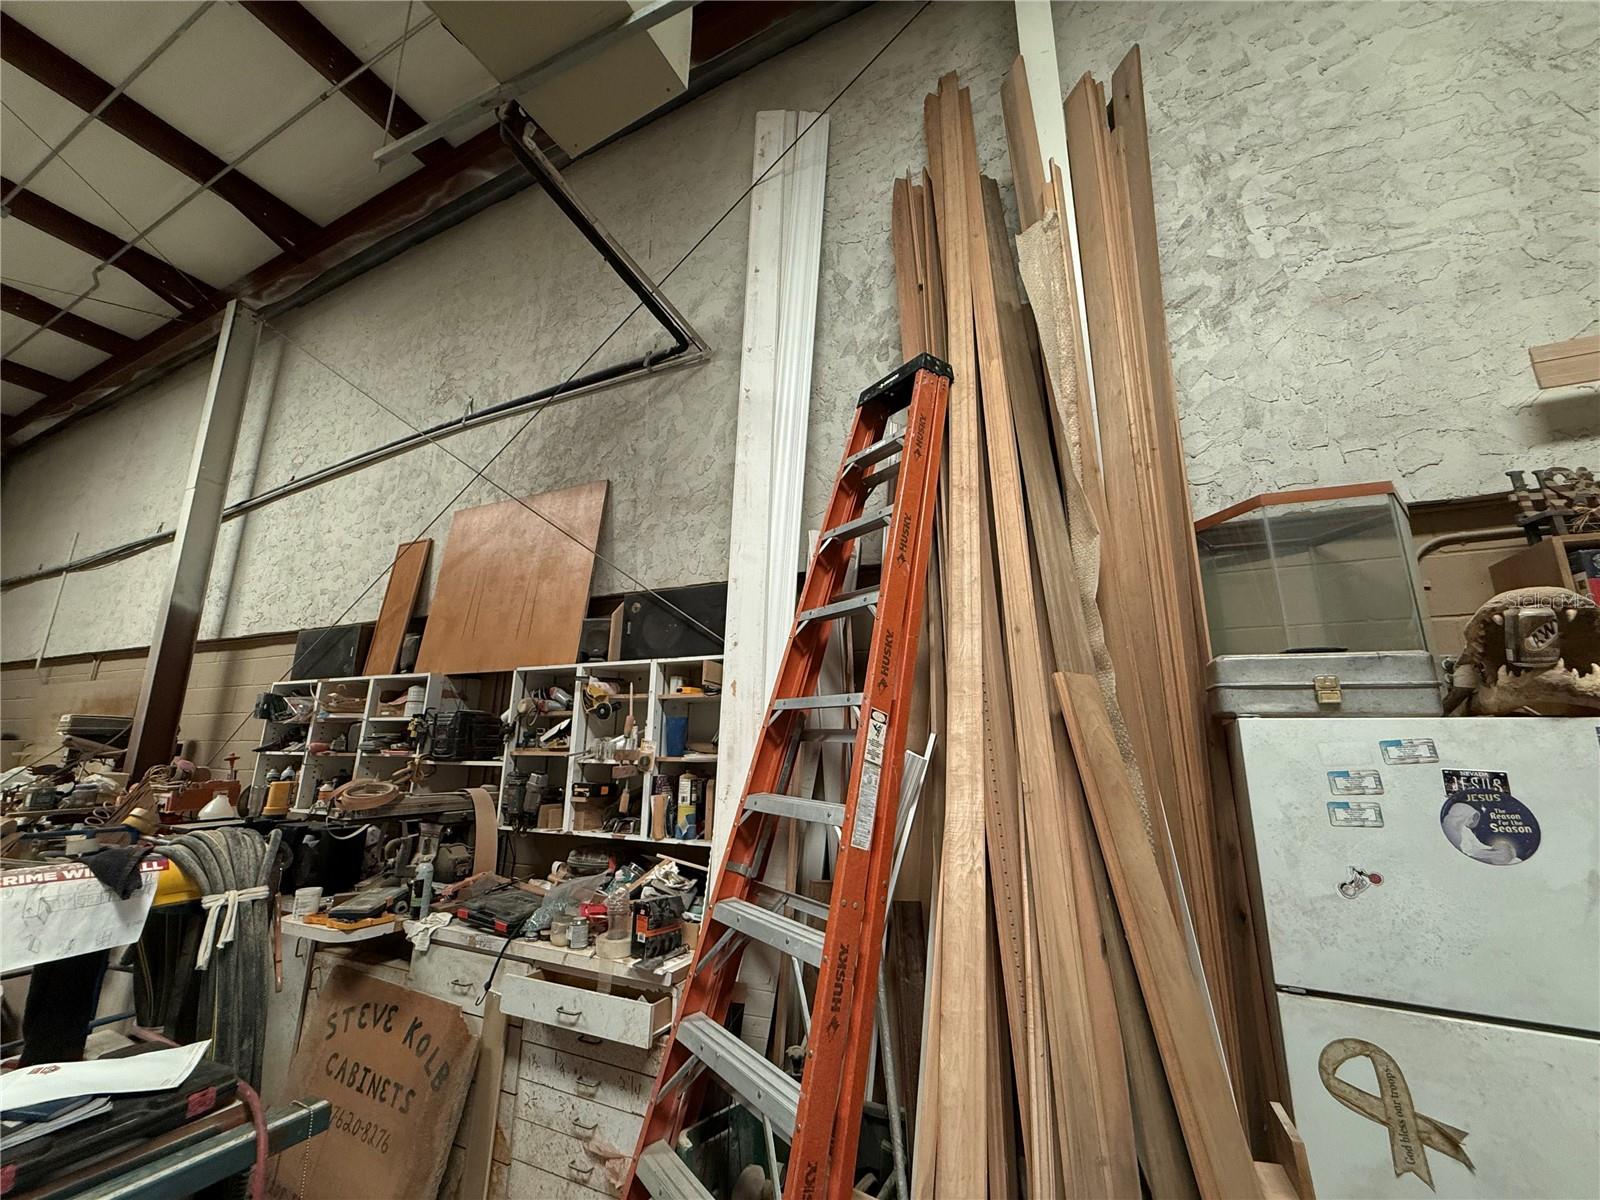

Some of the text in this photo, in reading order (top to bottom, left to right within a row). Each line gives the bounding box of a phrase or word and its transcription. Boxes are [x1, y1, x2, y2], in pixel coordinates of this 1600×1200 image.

[915, 414, 927, 448] HUSKY
[898, 513, 912, 552] HUSKY
[1530, 619, 1558, 649] AW
[880, 629, 894, 676] HUSKY
[1452, 775, 1503, 793] JESUS
[1466, 793, 1502, 802] JESUS
[1489, 811, 1522, 820] Reason
[1489, 823, 1533, 833] Season
[0, 871, 58, 886] RIME
[831, 943, 849, 1013] HUSKY
[325, 1002, 450, 1092] STEVE KOLB
[325, 1052, 417, 1114] CABINETS
[1394, 1101, 1404, 1118] our
[1399, 1120, 1410, 1144] bless
[1402, 1144, 1416, 1165] God
[803, 1161, 818, 1200] SKY
